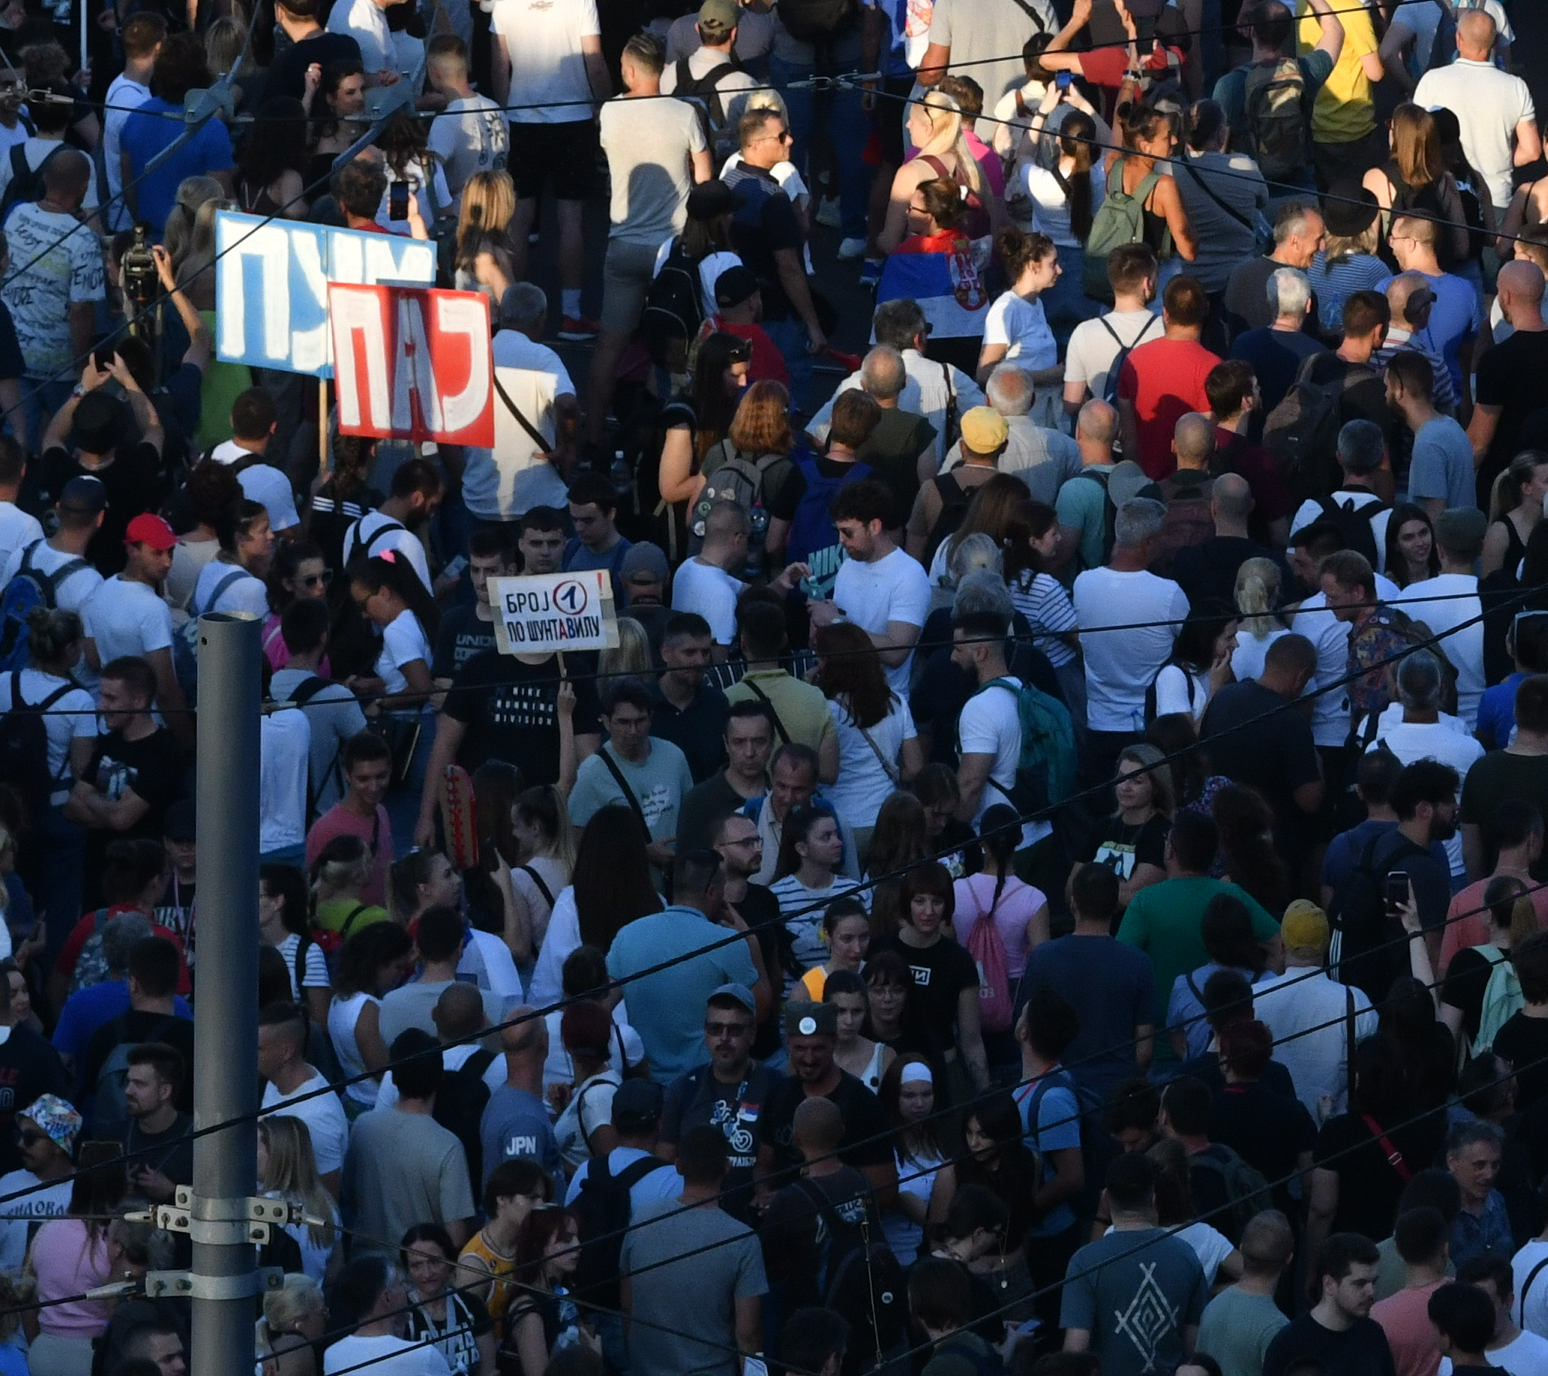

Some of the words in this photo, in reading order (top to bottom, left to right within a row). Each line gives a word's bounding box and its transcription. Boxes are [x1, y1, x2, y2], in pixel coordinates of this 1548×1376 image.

[217, 216, 433, 374] ПУМ
[330, 290, 488, 432] ПАЈ
[808, 541, 845, 579] NIK
[505, 591, 550, 614] БРОЈ
[506, 618, 526, 643] ПО
[526, 614, 601, 642] ШУНТАВИЛУ
[505, 1136, 537, 1156] JPN
